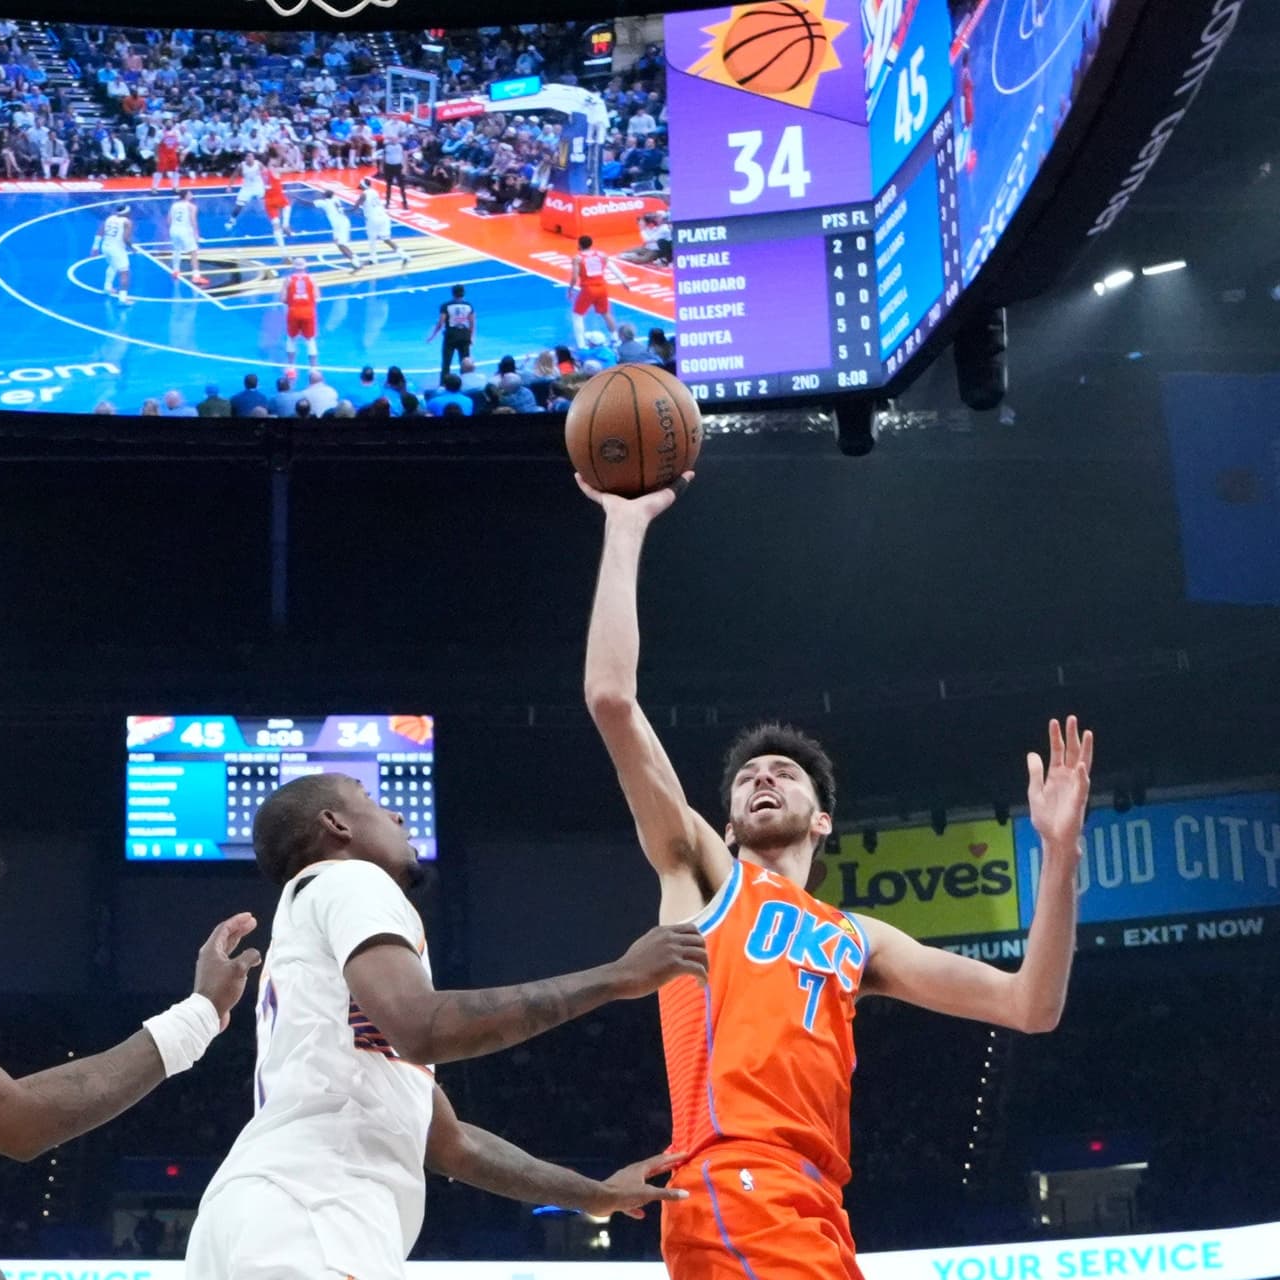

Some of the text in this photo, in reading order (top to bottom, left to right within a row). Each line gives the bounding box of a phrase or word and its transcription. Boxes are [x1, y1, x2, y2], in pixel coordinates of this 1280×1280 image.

[893, 45, 929, 145] 45
[726, 124, 811, 205] 34
[1086, 108, 1186, 236] Center
[581, 199, 645, 217] coinbase
[678, 211, 869, 243] PLAYER PTS FL
[677, 237, 866, 268] O'NEALE 2 0
[678, 263, 867, 294] IGHODARO 4 0
[679, 289, 869, 320] GILLESPIE 0 0
[680, 316, 870, 347] BOUYEA 5 0
[681, 343, 870, 373] GOODWIN 5 1
[691, 370, 867, 399] TO 5 TF 2 2ND 8:08
[180, 722, 225, 747] 45
[337, 722, 380, 747] 34
[744, 899, 864, 992] OKC
[1124, 922, 1186, 947] EXIT
[1197, 917, 1265, 940] NOW
[798, 969, 827, 1033] 7
[1057, 1240, 1223, 1280] SERVICE
